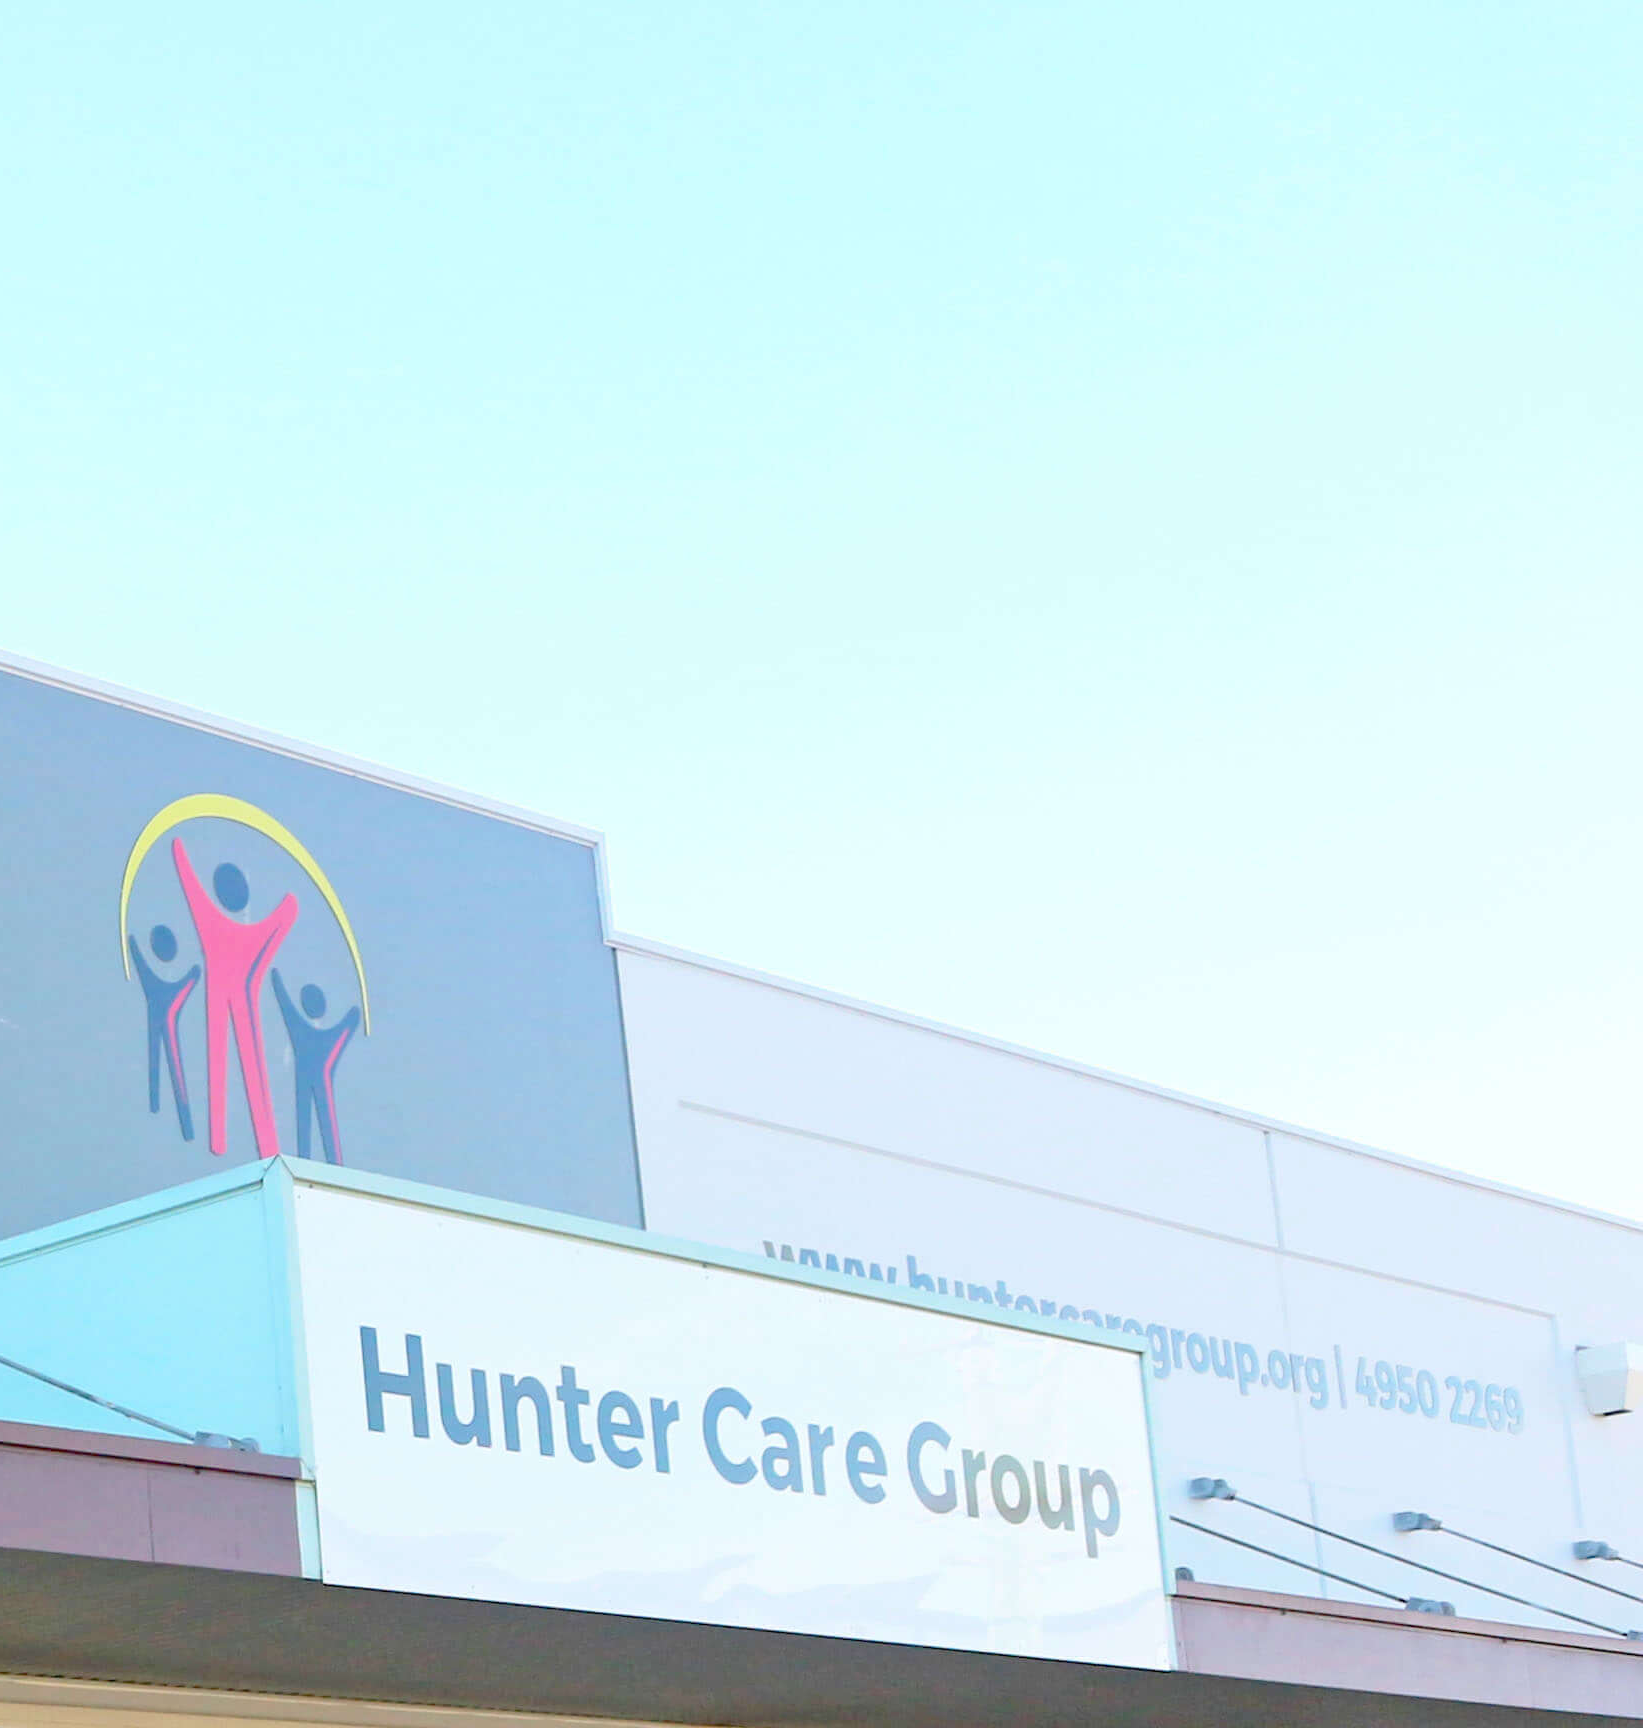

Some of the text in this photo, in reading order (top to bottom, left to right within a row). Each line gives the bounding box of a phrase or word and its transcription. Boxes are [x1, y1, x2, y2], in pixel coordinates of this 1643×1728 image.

[358, 1324, 1121, 1560] Hunter Care Group
[1354, 1356, 1442, 1420] 4950
[1444, 1375, 1526, 1436] 2269
